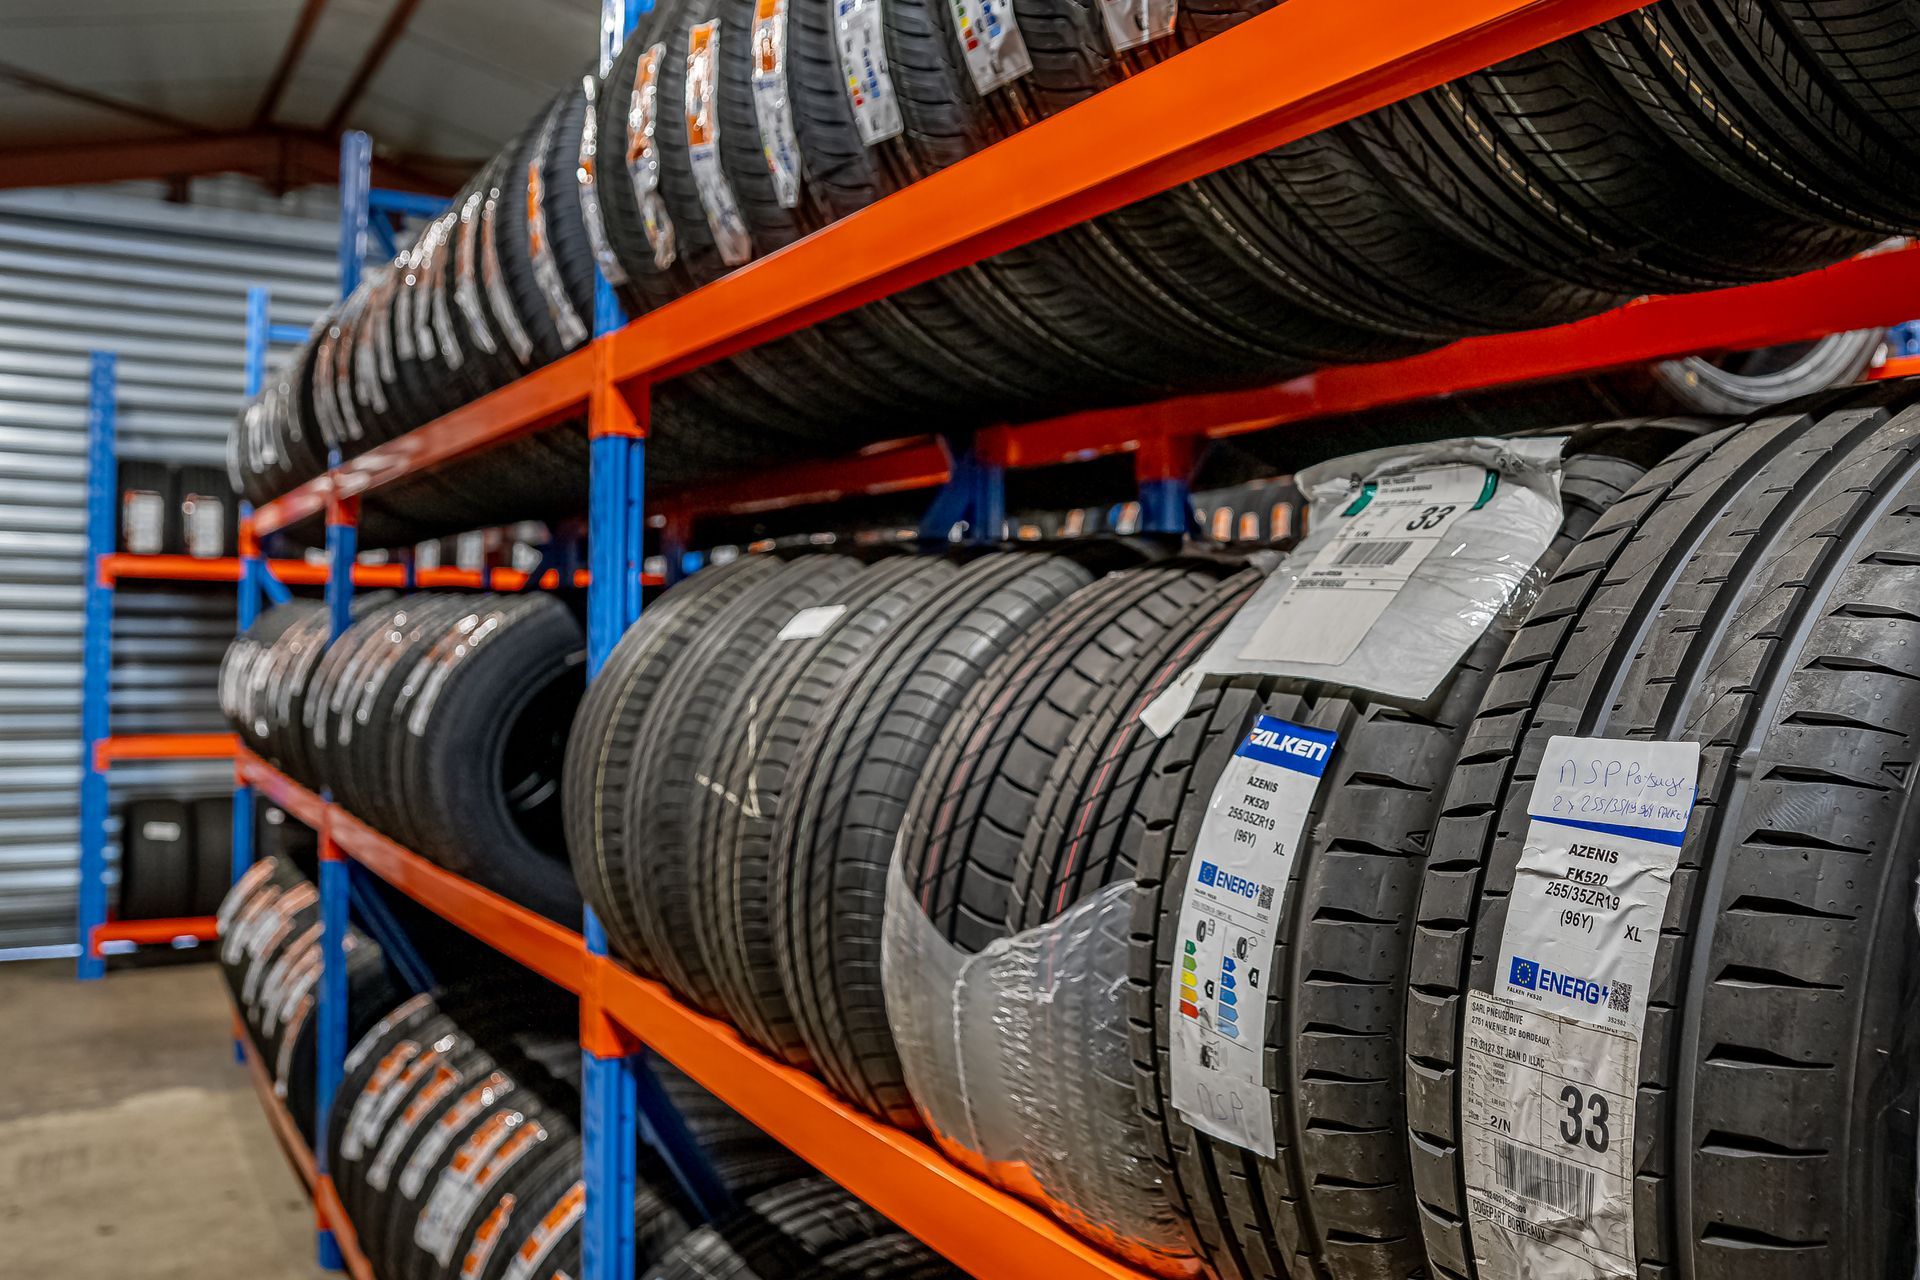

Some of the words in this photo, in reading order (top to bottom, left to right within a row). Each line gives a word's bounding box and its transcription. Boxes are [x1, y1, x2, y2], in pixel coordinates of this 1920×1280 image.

[1406, 505, 1456, 531] 33
[1249, 727, 1327, 761] FALKEN
[1246, 775, 1279, 793] AZENIS
[1243, 794, 1270, 811] FK520
[1227, 806, 1276, 831] 255/35ZR19
[1233, 829, 1257, 849] (96Y)
[1273, 842, 1286, 857] XL
[1568, 843, 1620, 864] AZENIS
[1216, 870, 1254, 899] ENERG
[1565, 867, 1608, 886] FK520
[1545, 881, 1621, 911] 255/35ZR19
[1560, 909, 1594, 934] (96Y)
[1624, 924, 1642, 943] XL
[1506, 985, 1525, 997] FALKEN
[1539, 968, 1600, 1006] ENERG
[1472, 1001, 1486, 1015] SARL
[1471, 1016, 1484, 1027] 2751
[1485, 1020, 1507, 1034] AVENUE
[1509, 1027, 1517, 1037] DE
[1518, 1029, 1551, 1047] BORDEAUX
[1470, 1037, 1478, 1048] FR
[1505, 1048, 1521, 1061] JEAN
[1490, 1115, 1511, 1134] 2/N
[1560, 1085, 1610, 1153] 33
[1473, 1199, 1505, 1225] COGEPART
[1507, 1215, 1547, 1241] BORDEAUX
